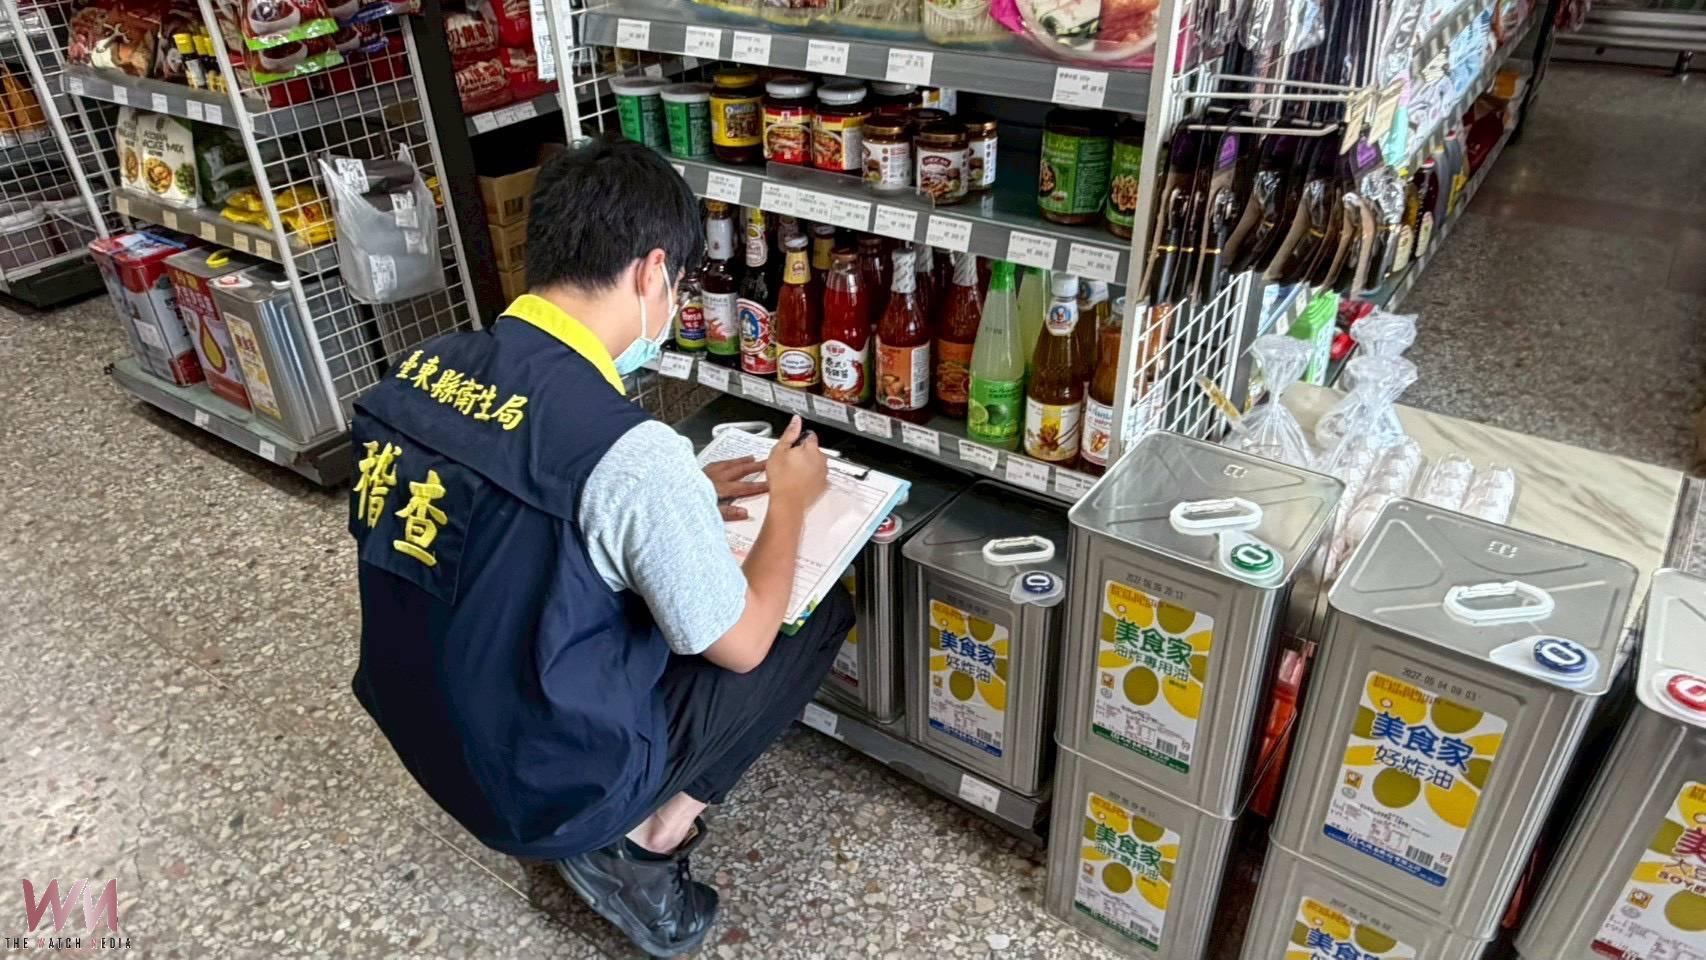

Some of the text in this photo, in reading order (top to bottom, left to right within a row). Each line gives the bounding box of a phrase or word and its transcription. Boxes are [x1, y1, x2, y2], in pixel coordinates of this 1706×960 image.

[395, 350, 528, 430] 臺東縣衛生局
[353, 441, 448, 567] 稽查
[940, 630, 997, 670] 美食家
[1114, 642, 1190, 682] 油炸專用油
[1115, 617, 1192, 669] 美食家
[946, 654, 991, 684] 好炸油
[1371, 711, 1474, 772] 美食家
[1374, 745, 1455, 790] 好炸油
[1095, 822, 1162, 870] 美食家
[1308, 928, 1380, 960] 美食
